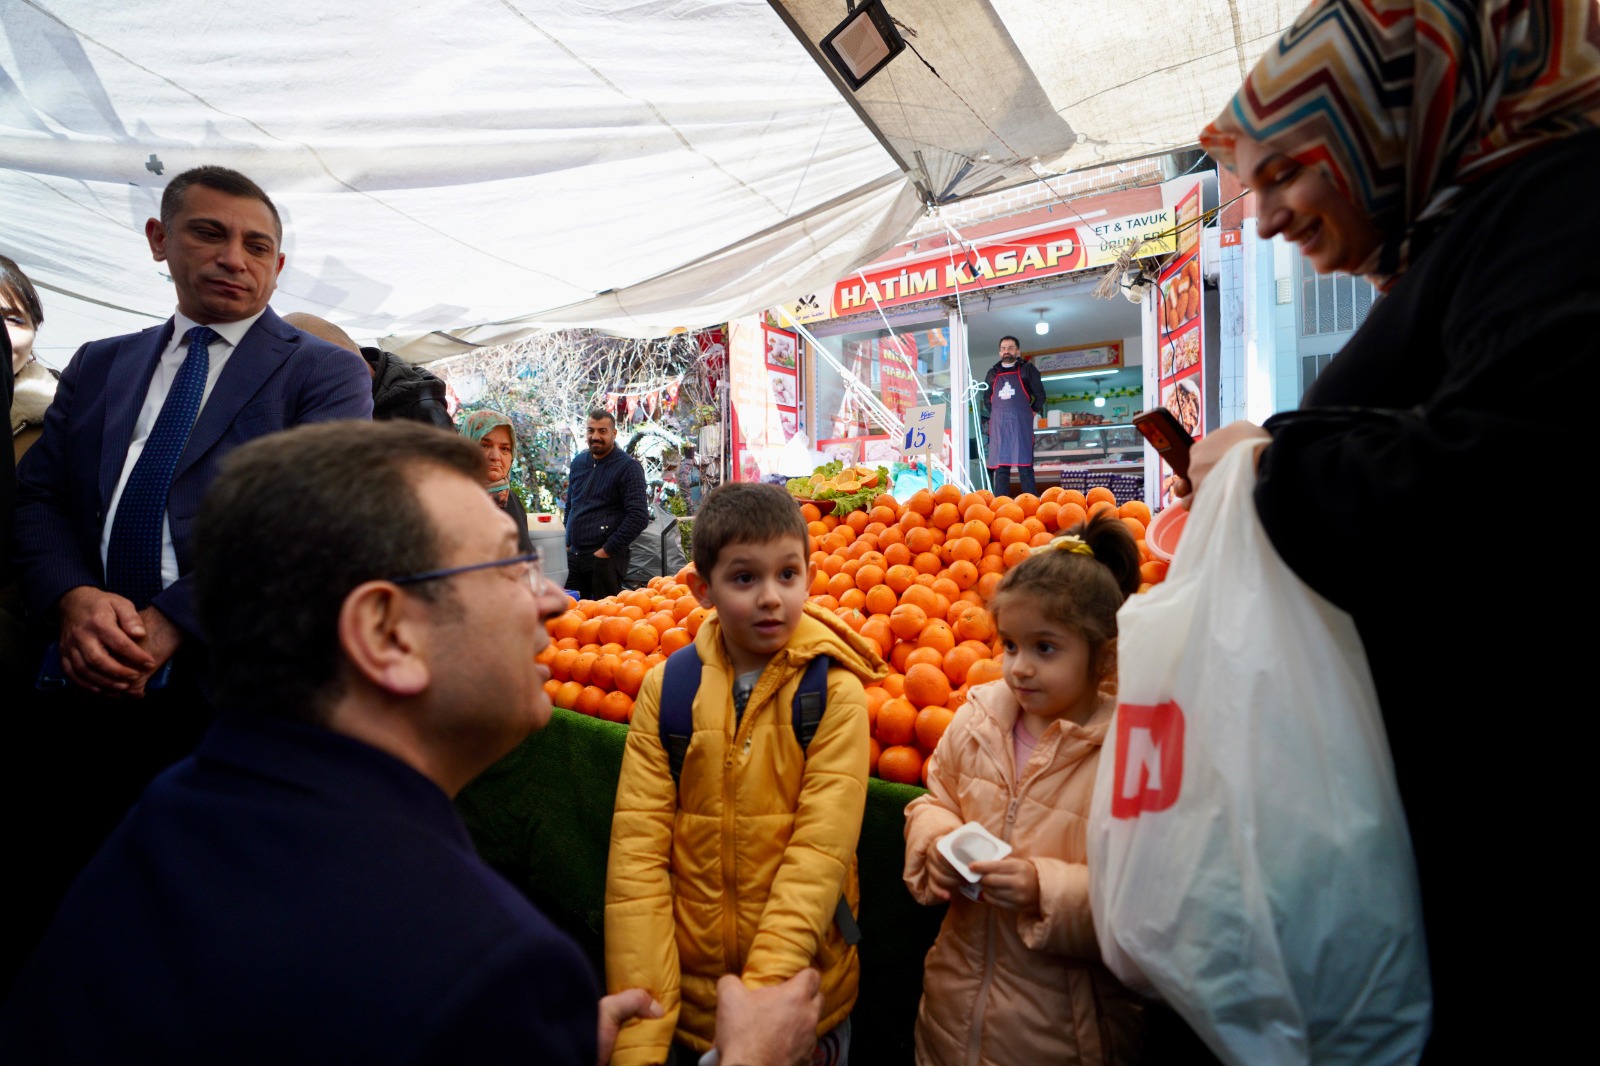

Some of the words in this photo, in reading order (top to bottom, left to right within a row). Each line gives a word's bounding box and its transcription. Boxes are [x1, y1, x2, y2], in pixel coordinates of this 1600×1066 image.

[1095, 225, 1110, 236] ET
[1113, 222, 1122, 232] &
[1126, 212, 1168, 229] TAVUK
[1100, 228, 1164, 252] ÜRÜNERİ
[1224, 232, 1236, 243] 71
[840, 269, 938, 310] HATİM
[945, 238, 1074, 287] KASAP
[905, 426, 926, 450] 15
